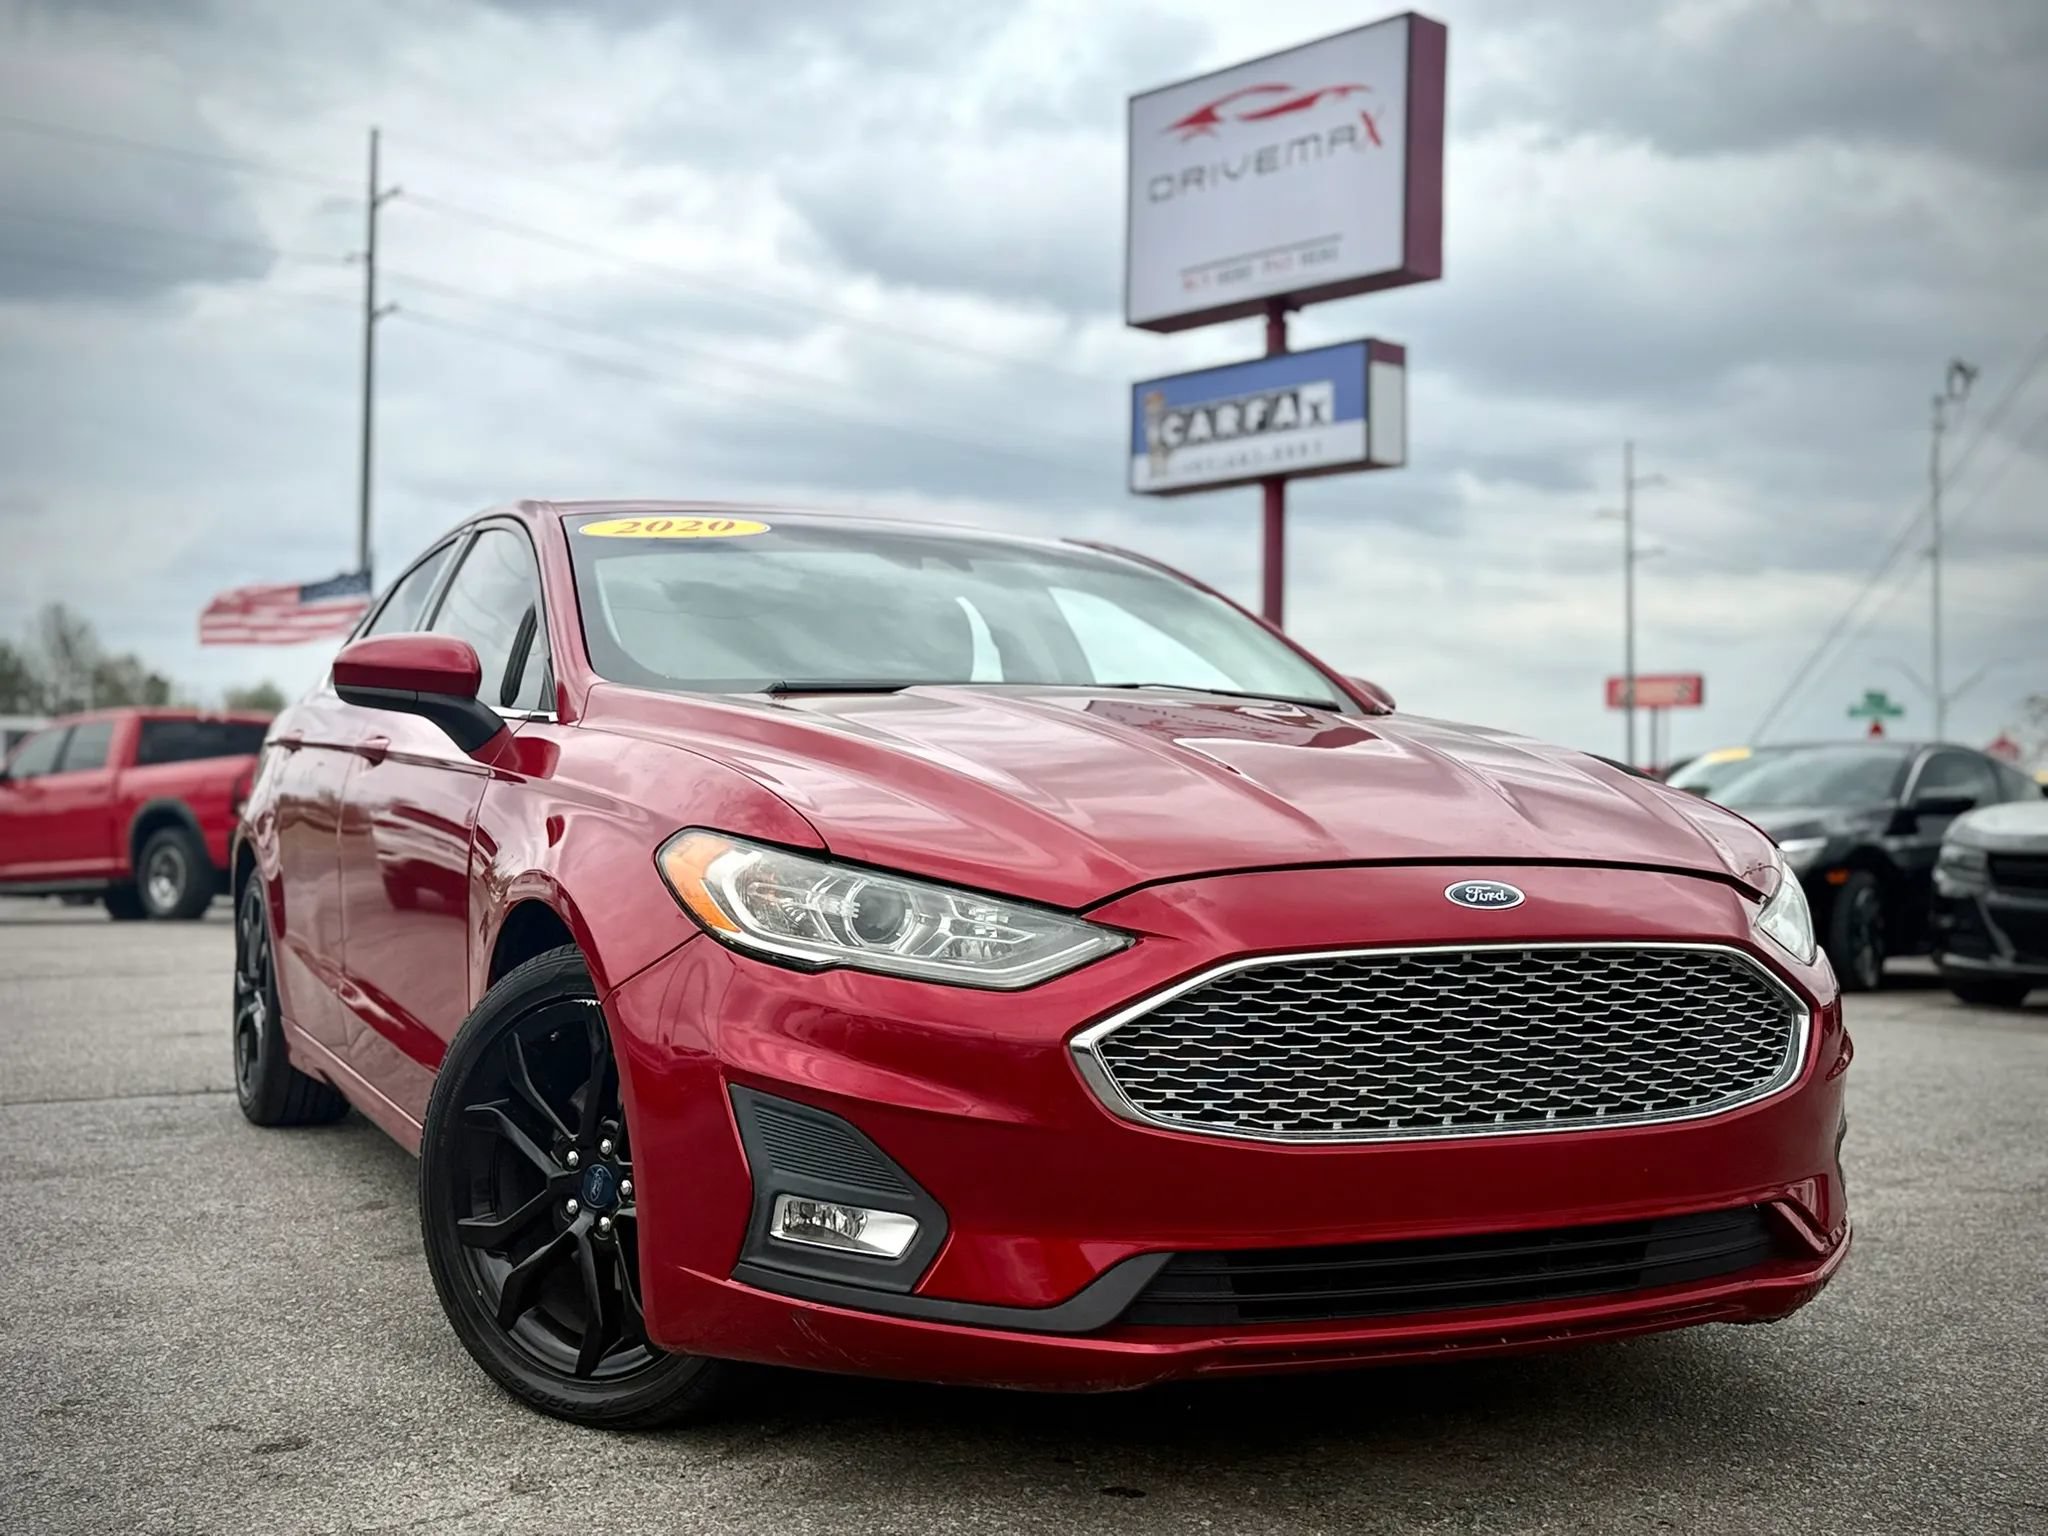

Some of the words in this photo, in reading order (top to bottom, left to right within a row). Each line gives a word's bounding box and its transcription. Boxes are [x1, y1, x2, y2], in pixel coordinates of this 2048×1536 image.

[1149, 104, 1386, 202] DRIVEMAX
[614, 519, 735, 534] 2020
[1465, 886, 1508, 903] Ford
